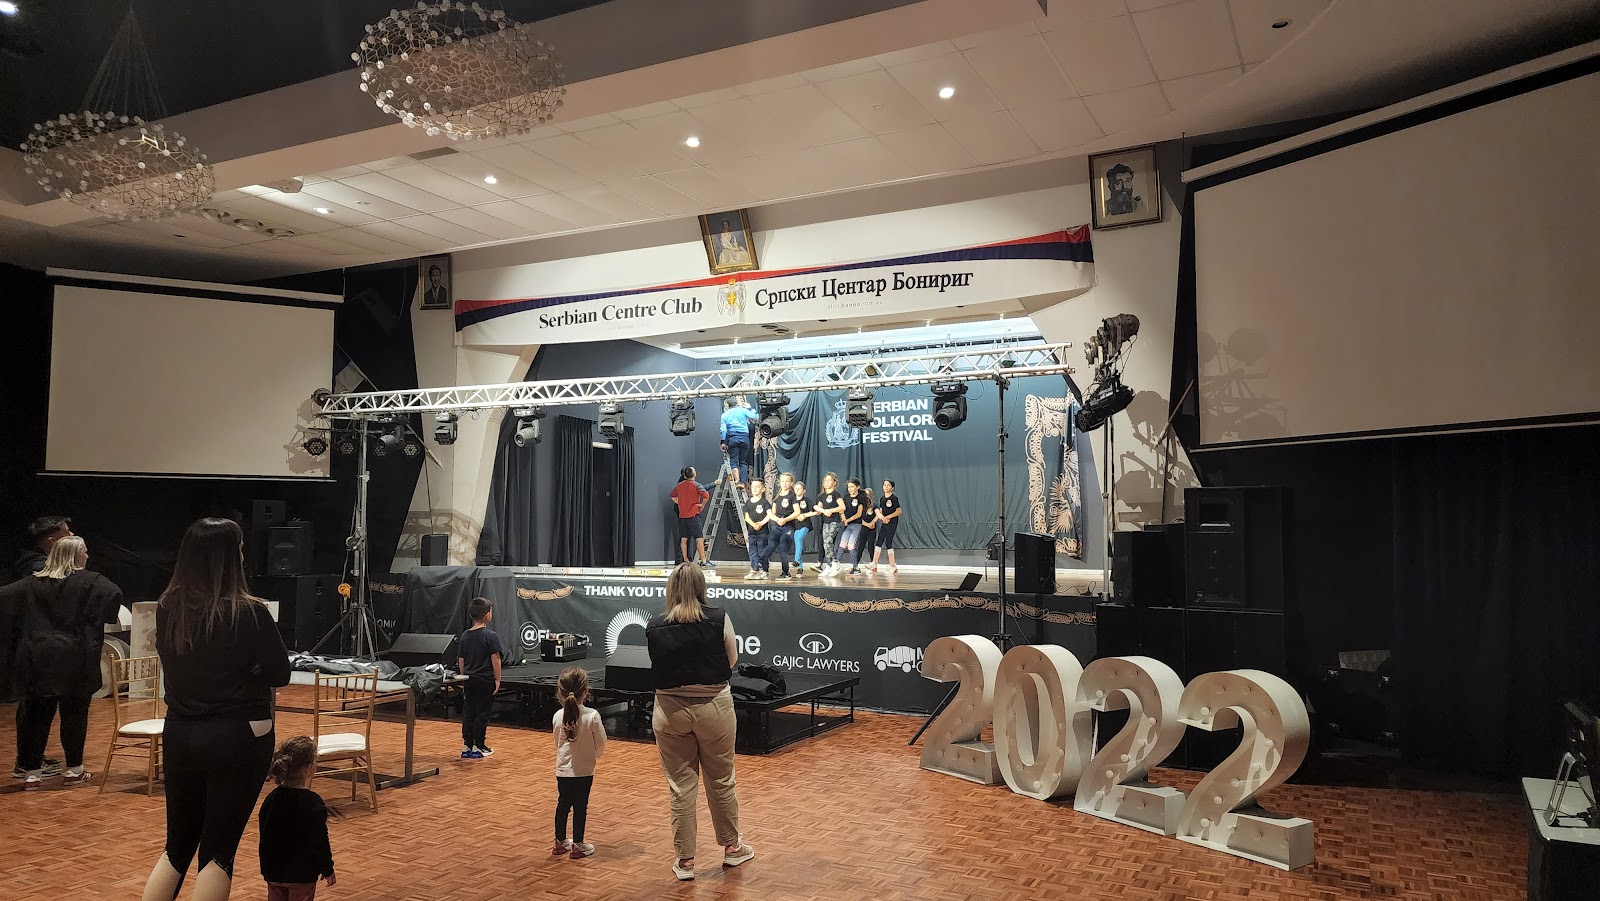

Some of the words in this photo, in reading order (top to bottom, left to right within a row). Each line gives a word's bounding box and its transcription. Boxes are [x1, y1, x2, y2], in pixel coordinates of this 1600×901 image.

[755, 284, 817, 309] Српски
[822, 277, 887, 300] Центар
[892, 272, 974, 292] Бонириг
[539, 309, 597, 329] Serbian
[602, 304, 657, 320] Centre
[661, 297, 703, 315] Club
[873, 399, 929, 413] ERBIAN
[870, 414, 936, 428] OLKLOR
[862, 430, 933, 444] FESTIVAL
[584, 585, 625, 597] THANK
[626, 586, 654, 598] YOU
[706, 588, 788, 602] SPONSORS!
[773, 655, 804, 671] GAJIC
[806, 658, 860, 673] LAWYERS
[920, 634, 1314, 871] 2022
